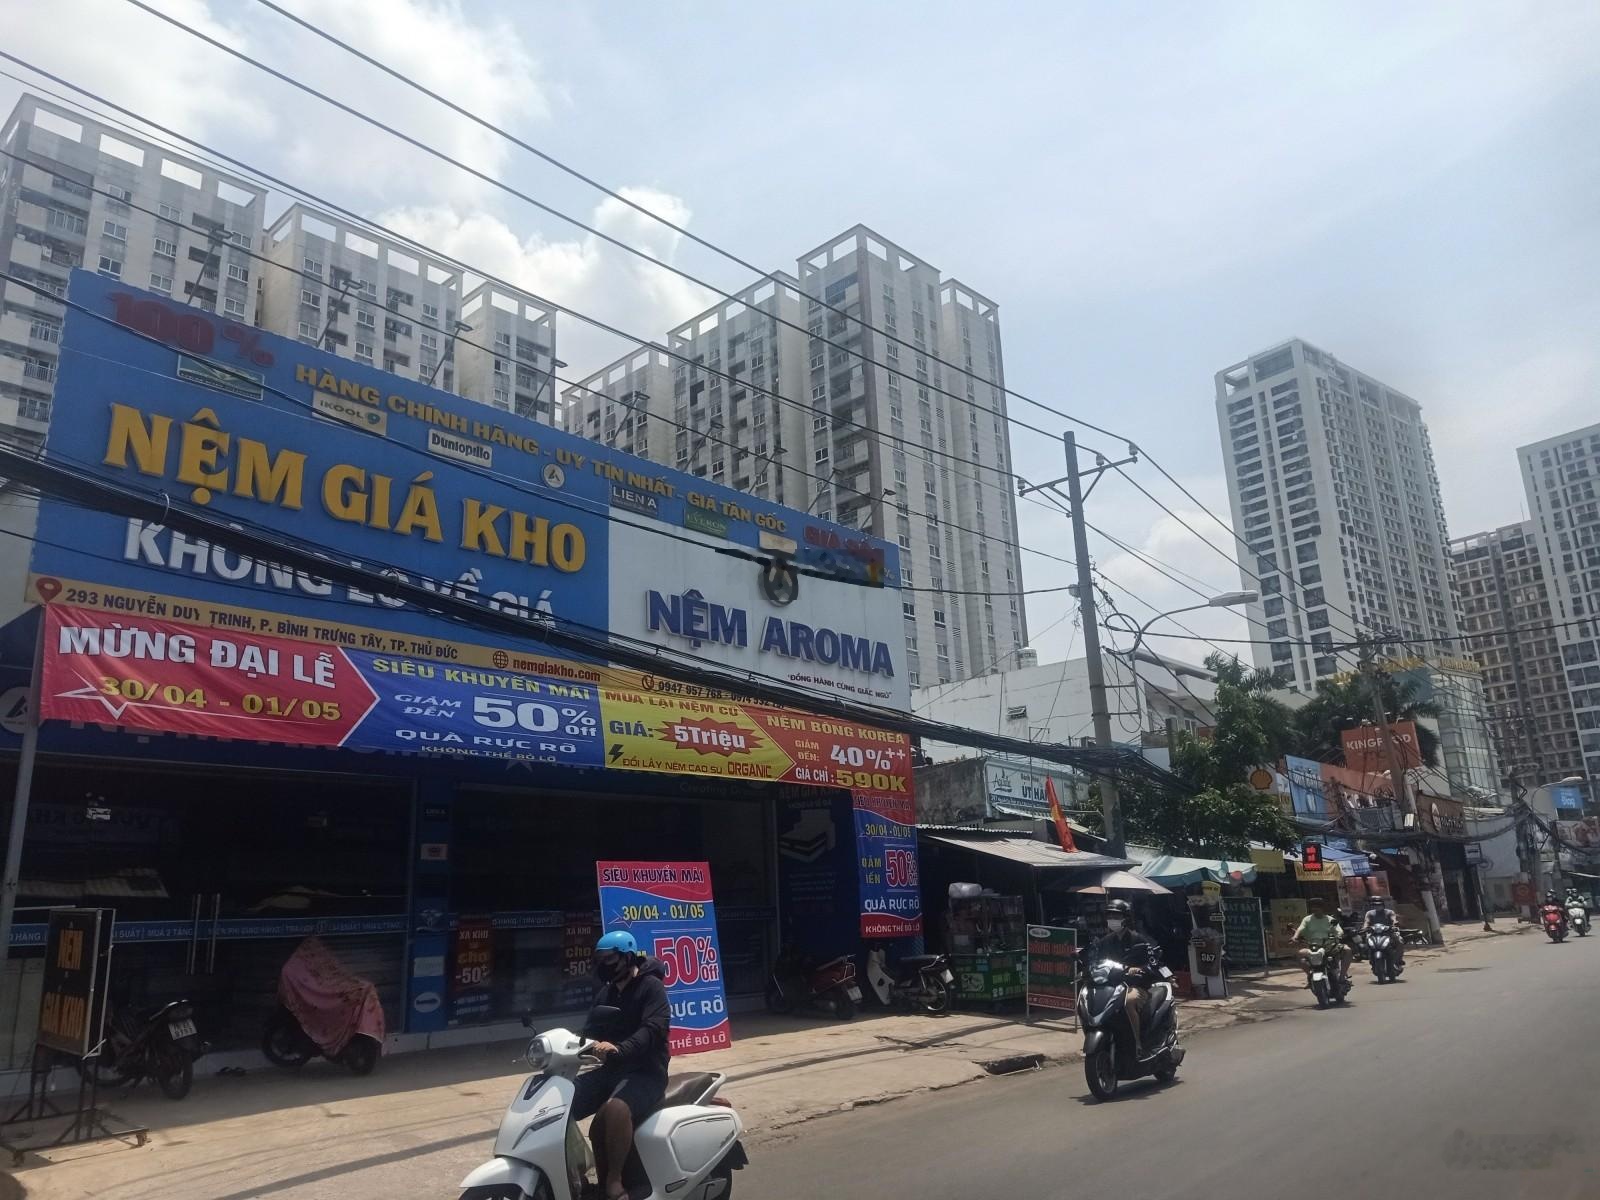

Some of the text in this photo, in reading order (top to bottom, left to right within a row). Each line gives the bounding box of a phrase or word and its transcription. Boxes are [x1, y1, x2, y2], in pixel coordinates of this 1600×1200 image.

[295, 364, 381, 406] HÀNG
[387, 395, 469, 433] CHÍNH
[473, 423, 541, 456] HÃNG
[556, 448, 586, 470] UY
[592, 458, 625, 482] TÍN
[628, 473, 676, 498] NHẤT
[687, 490, 717, 512] GIÁ
[720, 501, 752, 523] TẬN
[755, 511, 788, 533] GỐC
[103, 402, 586, 573] NỆM GIÁ KHO
[66, 588, 98, 605] 293
[103, 595, 167, 616] NGUYỄN
[172, 604, 201, 620] DUY
[260, 618, 273, 632] P.
[277, 619, 308, 638] BÌNH
[313, 626, 356, 645] TRƯNG
[360, 633, 387, 650] TÂY,
[390, 638, 408, 651] TP.
[411, 640, 432, 656] THỦ
[435, 645, 458, 660] ĐỨC
[647, 588, 895, 677] NỆM AROMA
[58, 622, 336, 689] MỪNG ĐẠI LỄ
[372, 657, 591, 700] SIÊU KHUYẾN MÃI
[512, 658, 601, 682] nemgiakho.com
[99, 676, 207, 708] 30/04
[241, 694, 341, 721] 01/05
[658, 681, 682, 694] 0947
[686, 685, 703, 697] 957
[706, 688, 722, 700] 768
[394, 692, 462, 709] GIẢM
[605, 690, 645, 704] MUA
[649, 695, 674, 710] LẠI
[678, 699, 715, 714] NỆM
[402, 704, 455, 718] ĐẾN
[565, 725, 598, 738] Off
[609, 719, 655, 738] GIÁ:
[674, 724, 746, 751] 5Triệu
[766, 714, 905, 744] NỆM BÔNG KOREA
[395, 728, 577, 754] QUÀ RỰC RỠ
[795, 739, 820, 751] GIẢM
[1346, 734, 1411, 751] KINGFOD
[421, 744, 479, 758] KHÔNG
[688, 764, 708, 774] CAO
[711, 765, 723, 775] SU
[727, 761, 772, 778] ORGANIC
[795, 766, 813, 783] GIÁ
[813, 766, 829, 783] CHỈ
[836, 769, 906, 792] 590K
[603, 865, 704, 884] SIÊU KHUYẾN MÃI
[621, 904, 660, 921] 30/04
[669, 904, 705, 919] 01/05
[864, 896, 888, 913] QUÀ
[888, 898, 908, 913] RỰC
[700, 964, 720, 982] Off
[701, 995, 724, 1014] RỠ
[669, 1030, 726, 1049] THỂ BỎ LỠ
